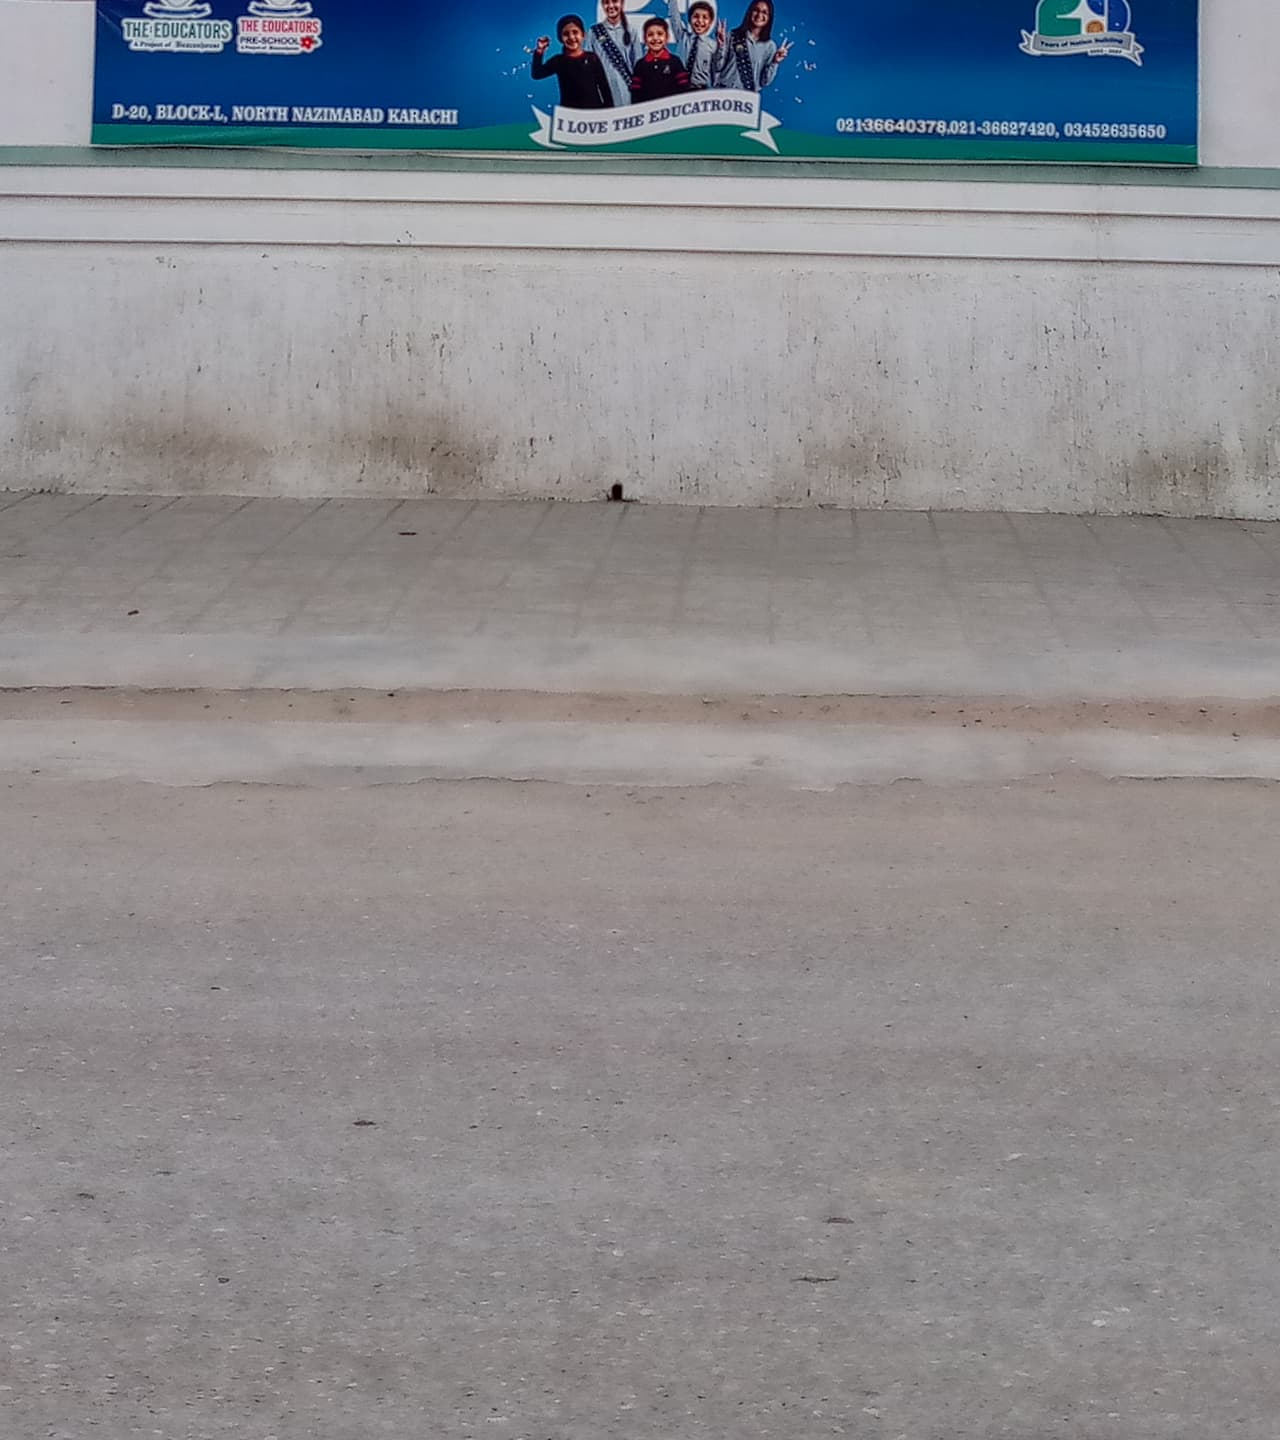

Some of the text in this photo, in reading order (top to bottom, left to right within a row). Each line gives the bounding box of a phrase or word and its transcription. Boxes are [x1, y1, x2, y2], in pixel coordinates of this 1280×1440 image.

[123, 21, 230, 39] THE EDUCATORS
[241, 20, 319, 33] THE EDUCATORS
[240, 36, 299, 45] PRE-SCHOOL
[112, 103, 458, 125] D-20, BLOCK-L, NORTH NAZIMABAD KARACHI
[557, 99, 754, 134] I LOVE THE EDUCATRORS
